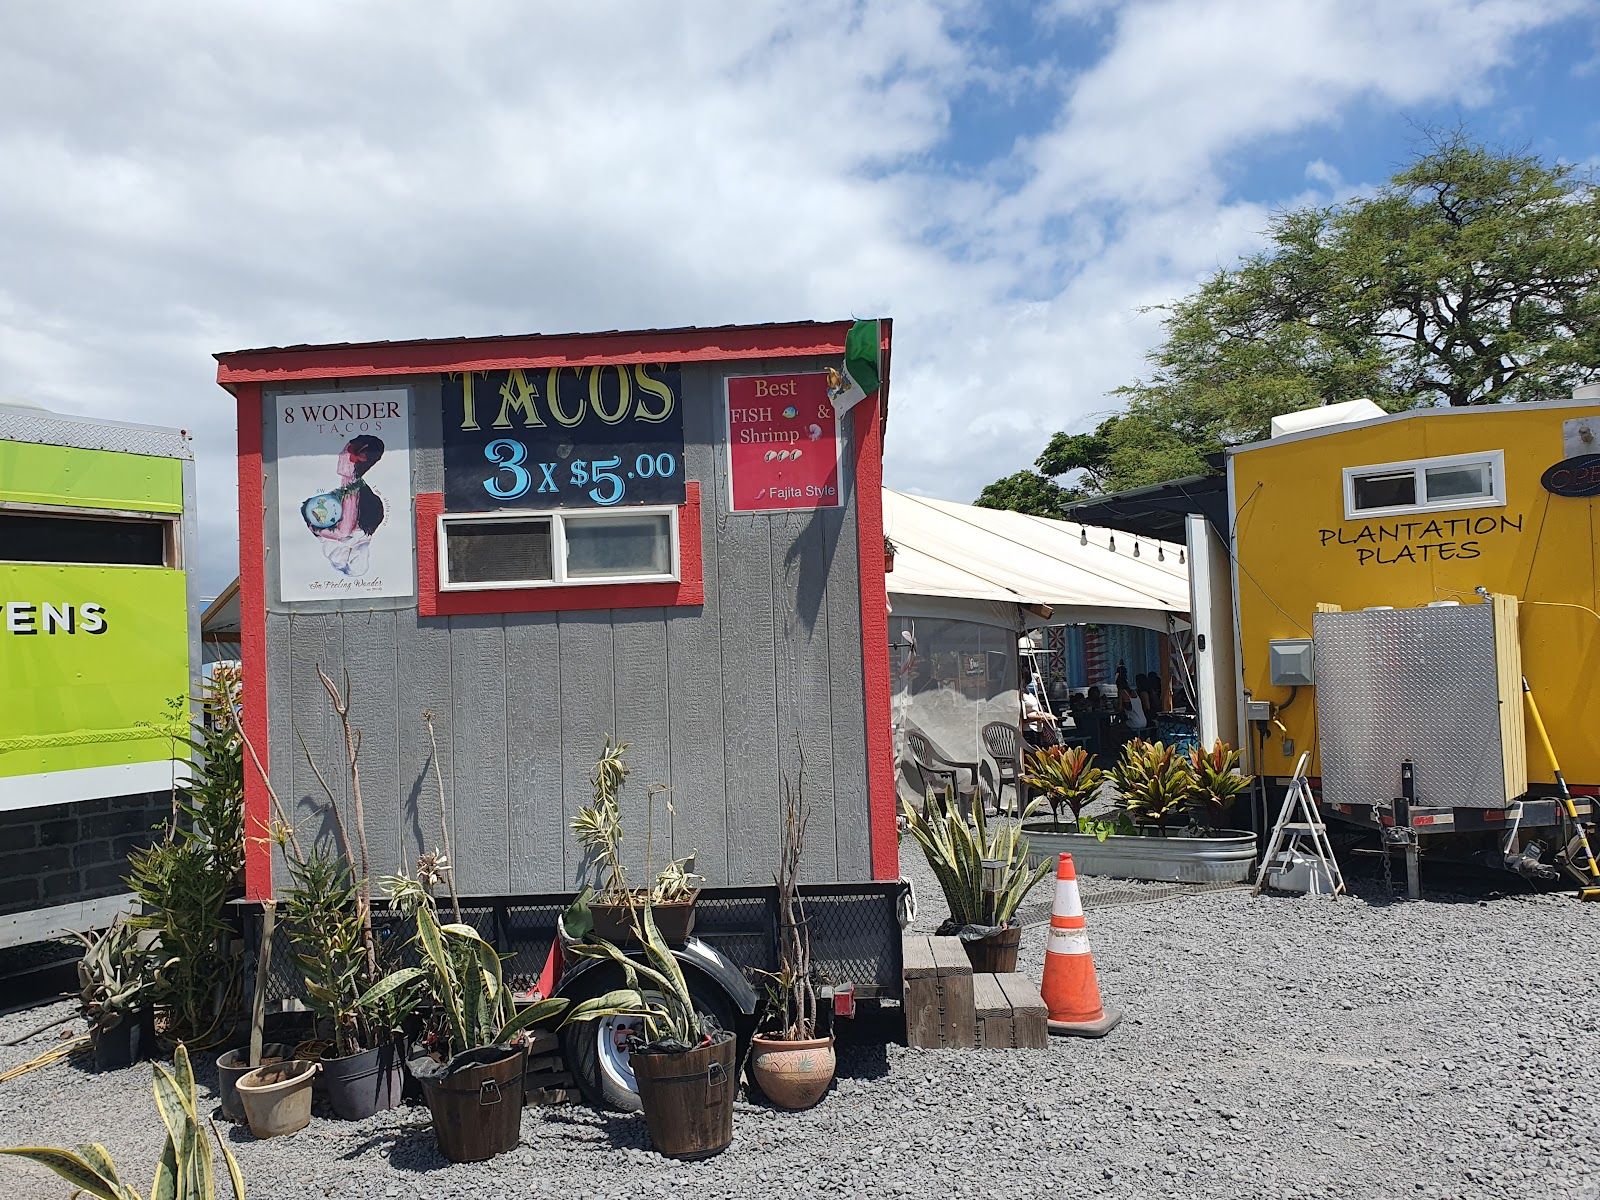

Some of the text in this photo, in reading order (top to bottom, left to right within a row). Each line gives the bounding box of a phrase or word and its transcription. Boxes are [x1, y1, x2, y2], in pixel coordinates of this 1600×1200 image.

[448, 362, 675, 431] TACOS
[754, 379, 797, 398] Best
[284, 401, 401, 424] 8 WONDER
[730, 404, 830, 424] FISH &
[316, 421, 383, 434] TACOS
[740, 427, 800, 445] Shrimp
[482, 438, 532, 501] 3
[570, 452, 676, 506] $5.00
[769, 485, 836, 500] Fajita Style
[1318, 513, 1523, 547] PLANTATION
[1356, 541, 1481, 566] PLATES
[0, 601, 108, 635] ENS
